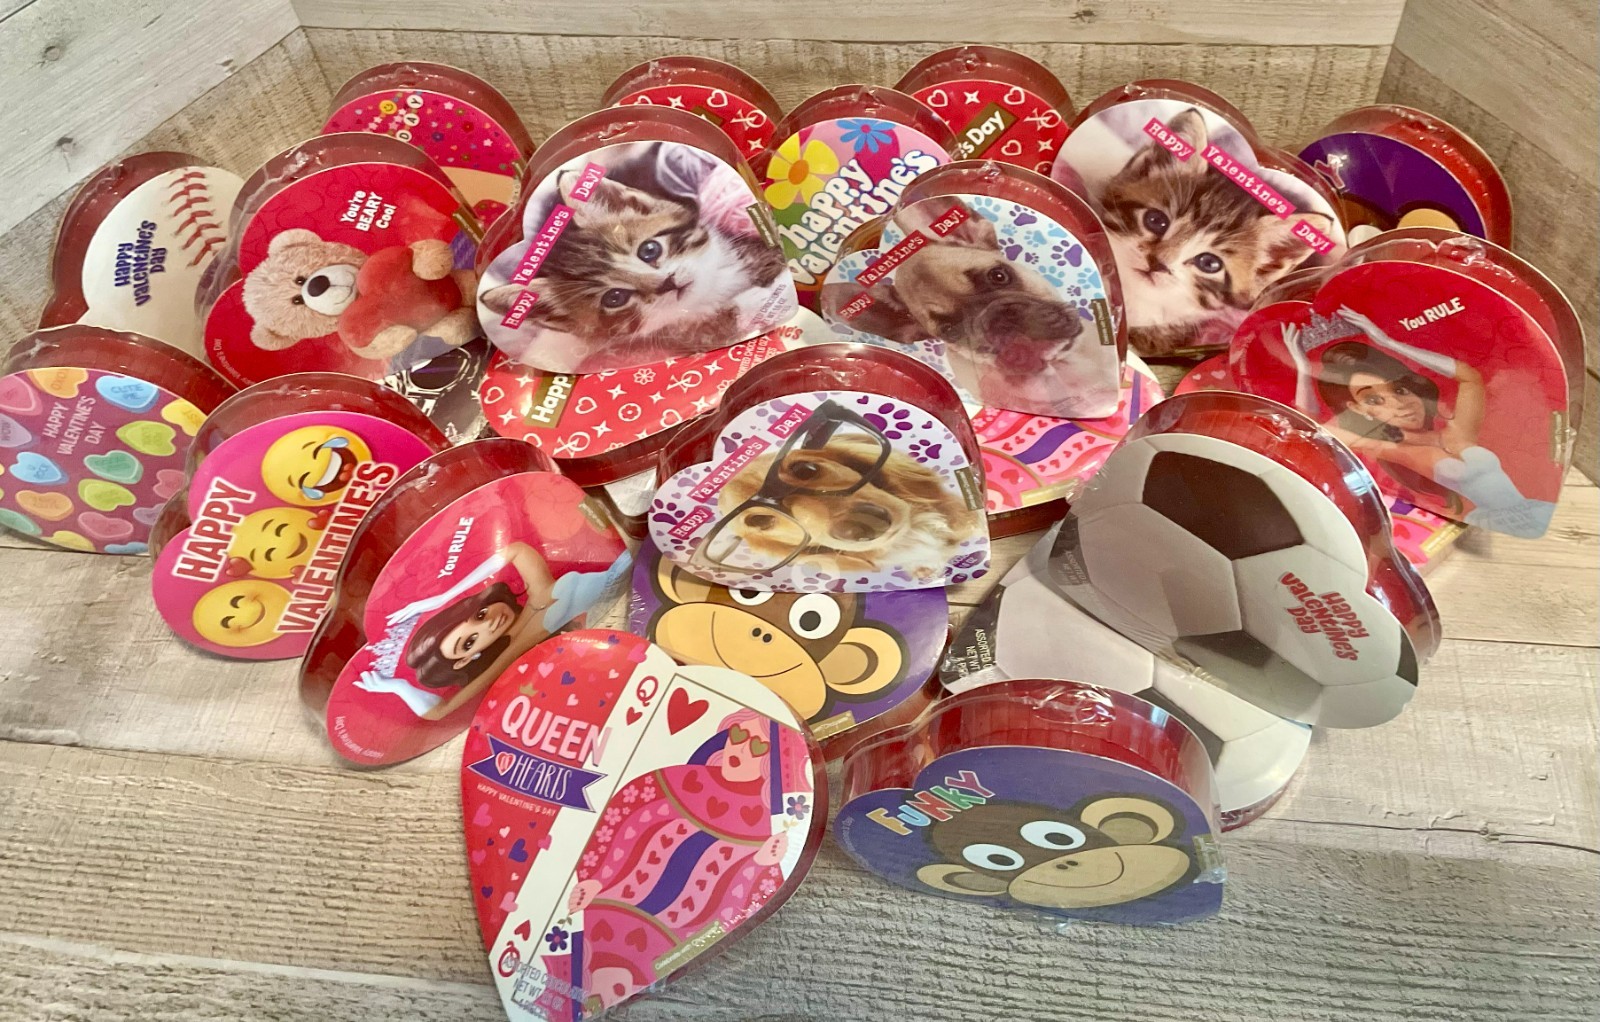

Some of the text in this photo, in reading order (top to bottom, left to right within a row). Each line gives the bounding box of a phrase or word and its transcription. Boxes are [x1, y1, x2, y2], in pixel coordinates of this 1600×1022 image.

[966, 110, 1005, 146] Day
[340, 190, 366, 222] You're
[1148, 122, 1192, 157] Happy
[1206, 146, 1288, 214] Valentine's
[1296, 224, 1330, 251] Day!
[355, 191, 383, 231] BEARY
[375, 203, 397, 229] Cool
[505, 168, 602, 327] Happy Valentine's Day!
[840, 209, 964, 318] Happy Valentine's Day!
[1398, 296, 1465, 331] You RULE
[42, 402, 69, 438] HAPPY
[531, 374, 576, 423] Happ
[84, 421, 106, 445] DAY
[673, 408, 806, 537] Happy Valentine's Day!
[173, 478, 256, 582] HAPPY
[275, 462, 398, 633] VALENTINE'S
[437, 517, 474, 578] You RULE
[966, 645, 981, 671] NET WT
[975, 628, 992, 663] ASSORTED
[636, 675, 659, 708] Q
[501, 695, 613, 767] QUEEN
[509, 754, 573, 801] HEARTS
[477, 783, 556, 816] HAPPY VALENTINE'S DAY
[865, 769, 996, 836] FUNKY
